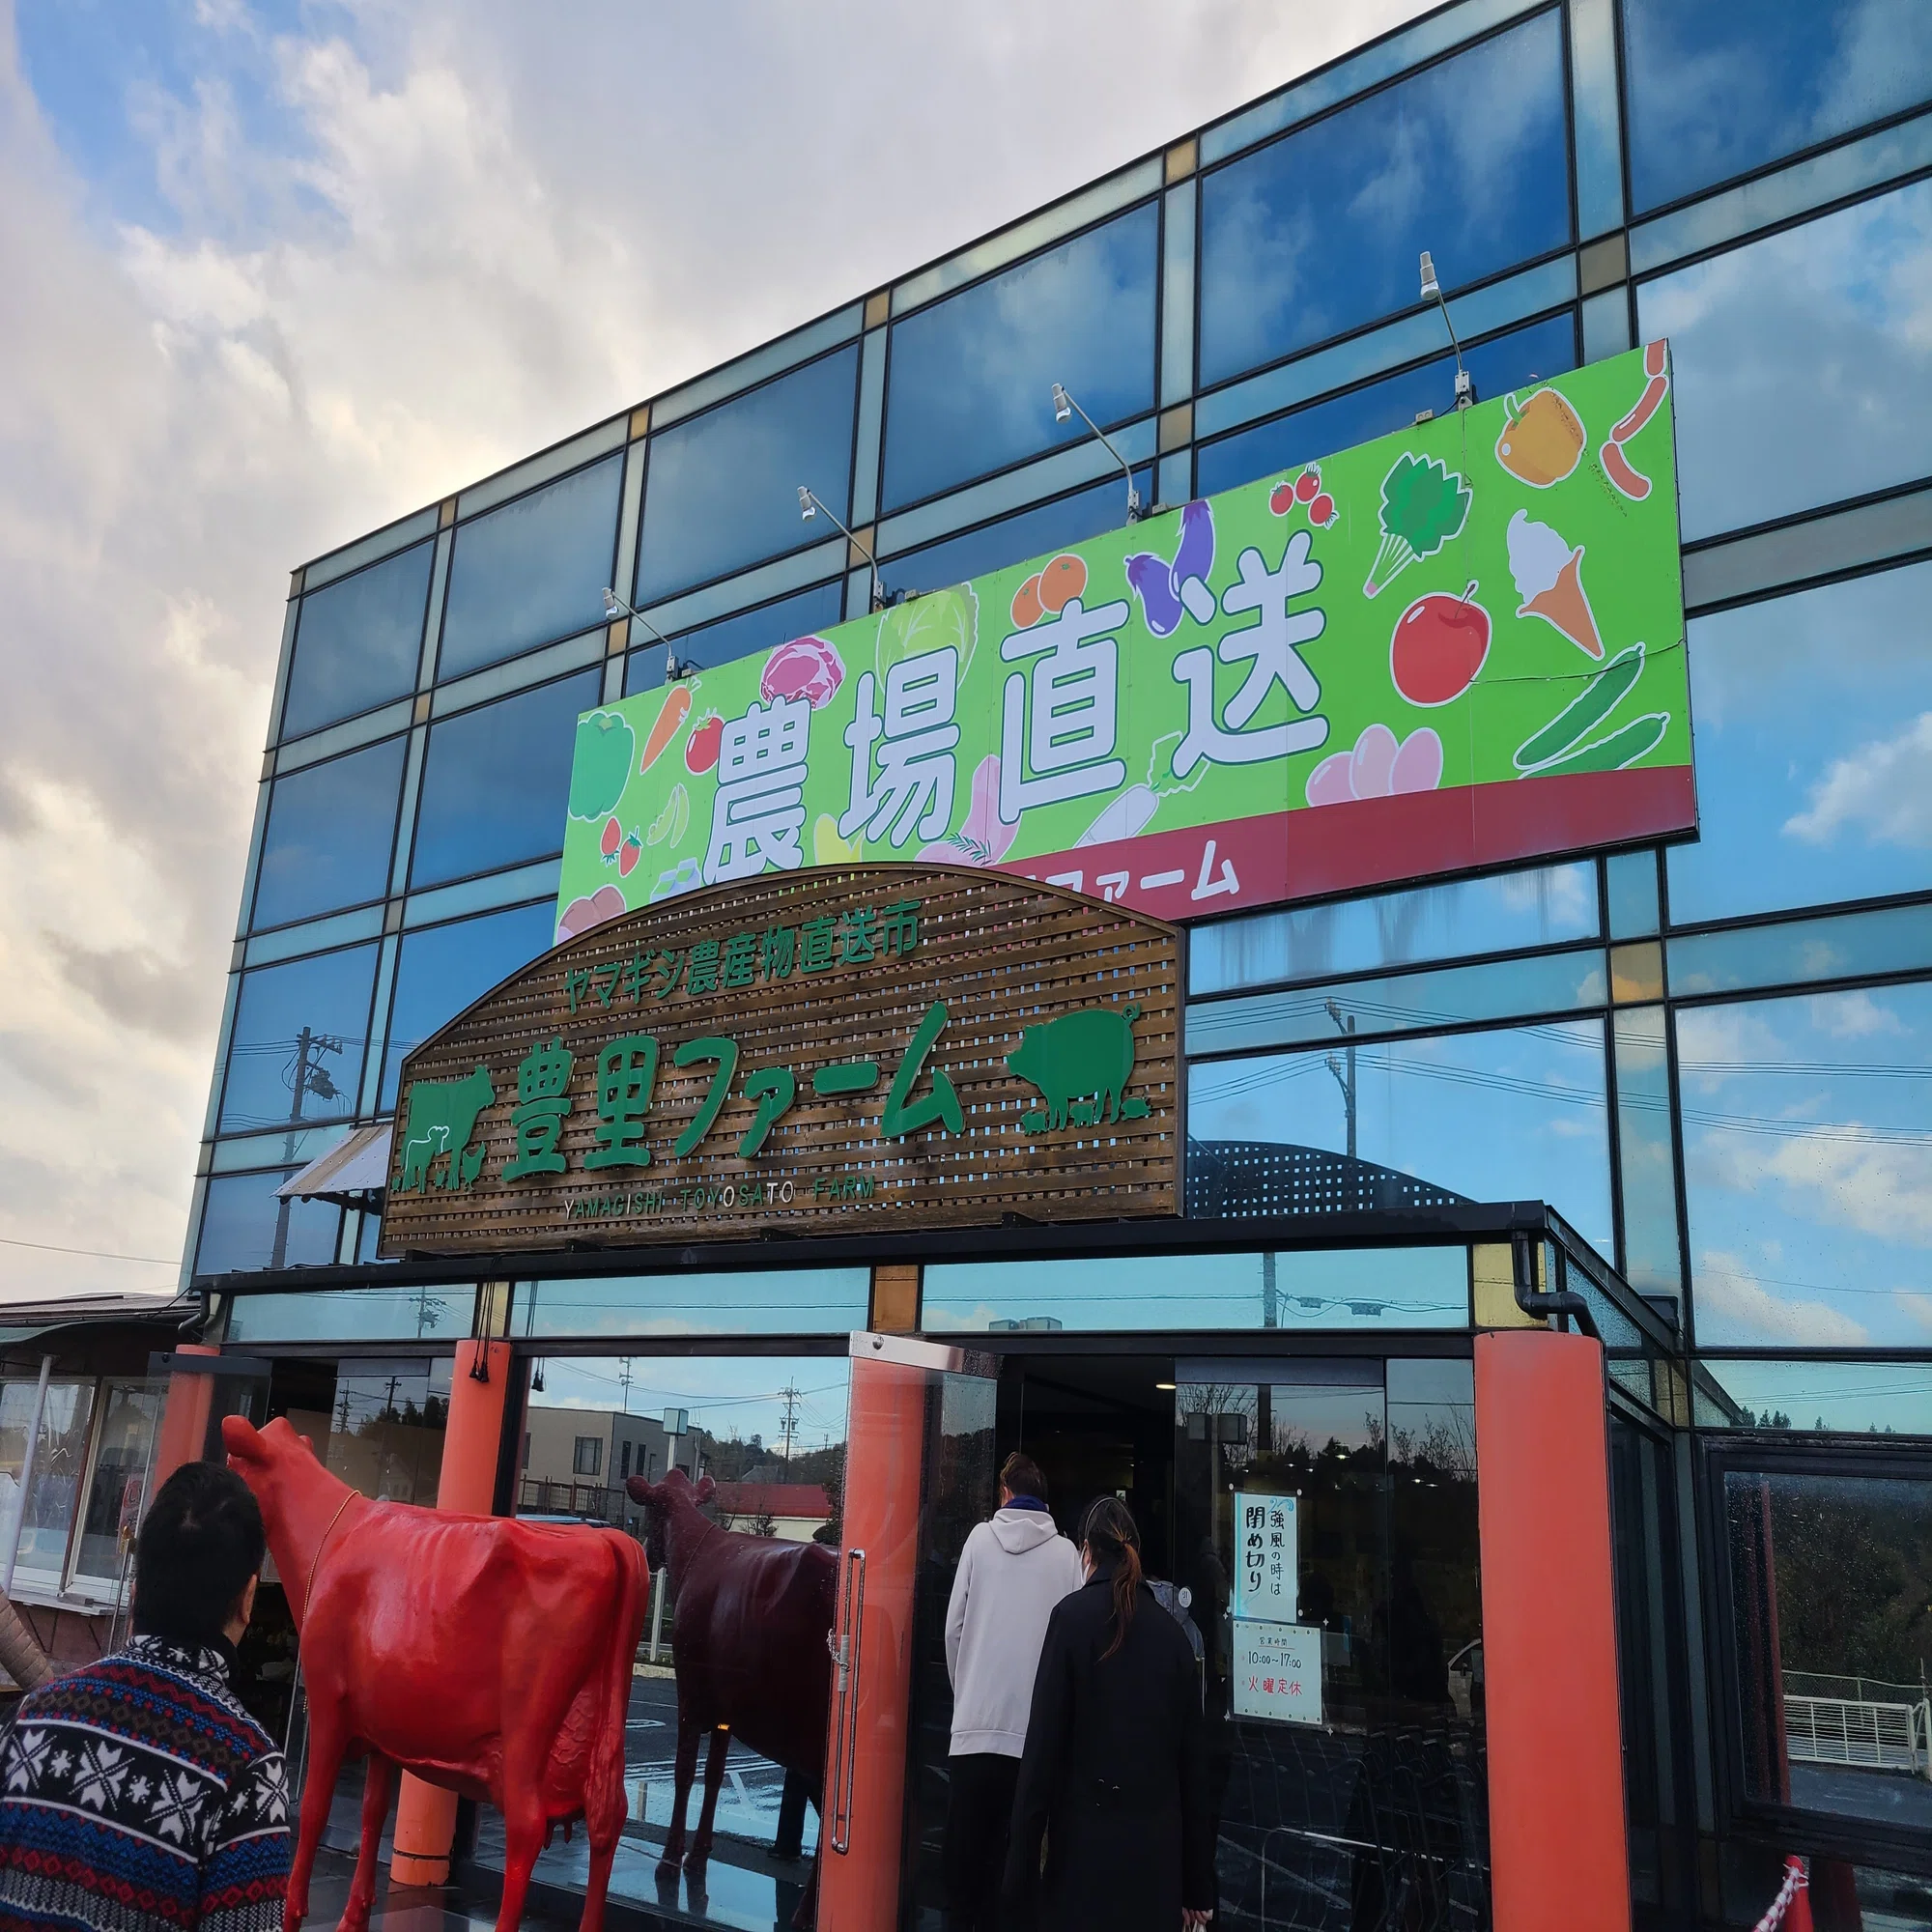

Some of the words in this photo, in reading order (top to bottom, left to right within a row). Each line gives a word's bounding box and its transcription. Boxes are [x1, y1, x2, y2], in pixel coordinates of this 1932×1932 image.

[702, 529, 1330, 885] 農場直送
[1025, 839, 1240, 904] ファーム
[564, 897, 921, 1015] ヤマギシ農産物直送市
[501, 1001, 966, 1183] 豊里ファーム
[563, 1190, 663, 1220] YAMAGISHI
[680, 1179, 795, 1211] TOYOSATO
[813, 1174, 875, 1202] FARM
[1245, 1506, 1265, 1593] 閉め切り
[1269, 1509, 1286, 1596] 強風の時は
[1259, 1636, 1288, 1647] 営業時間
[1248, 1675, 1303, 1697] 火曜定休
